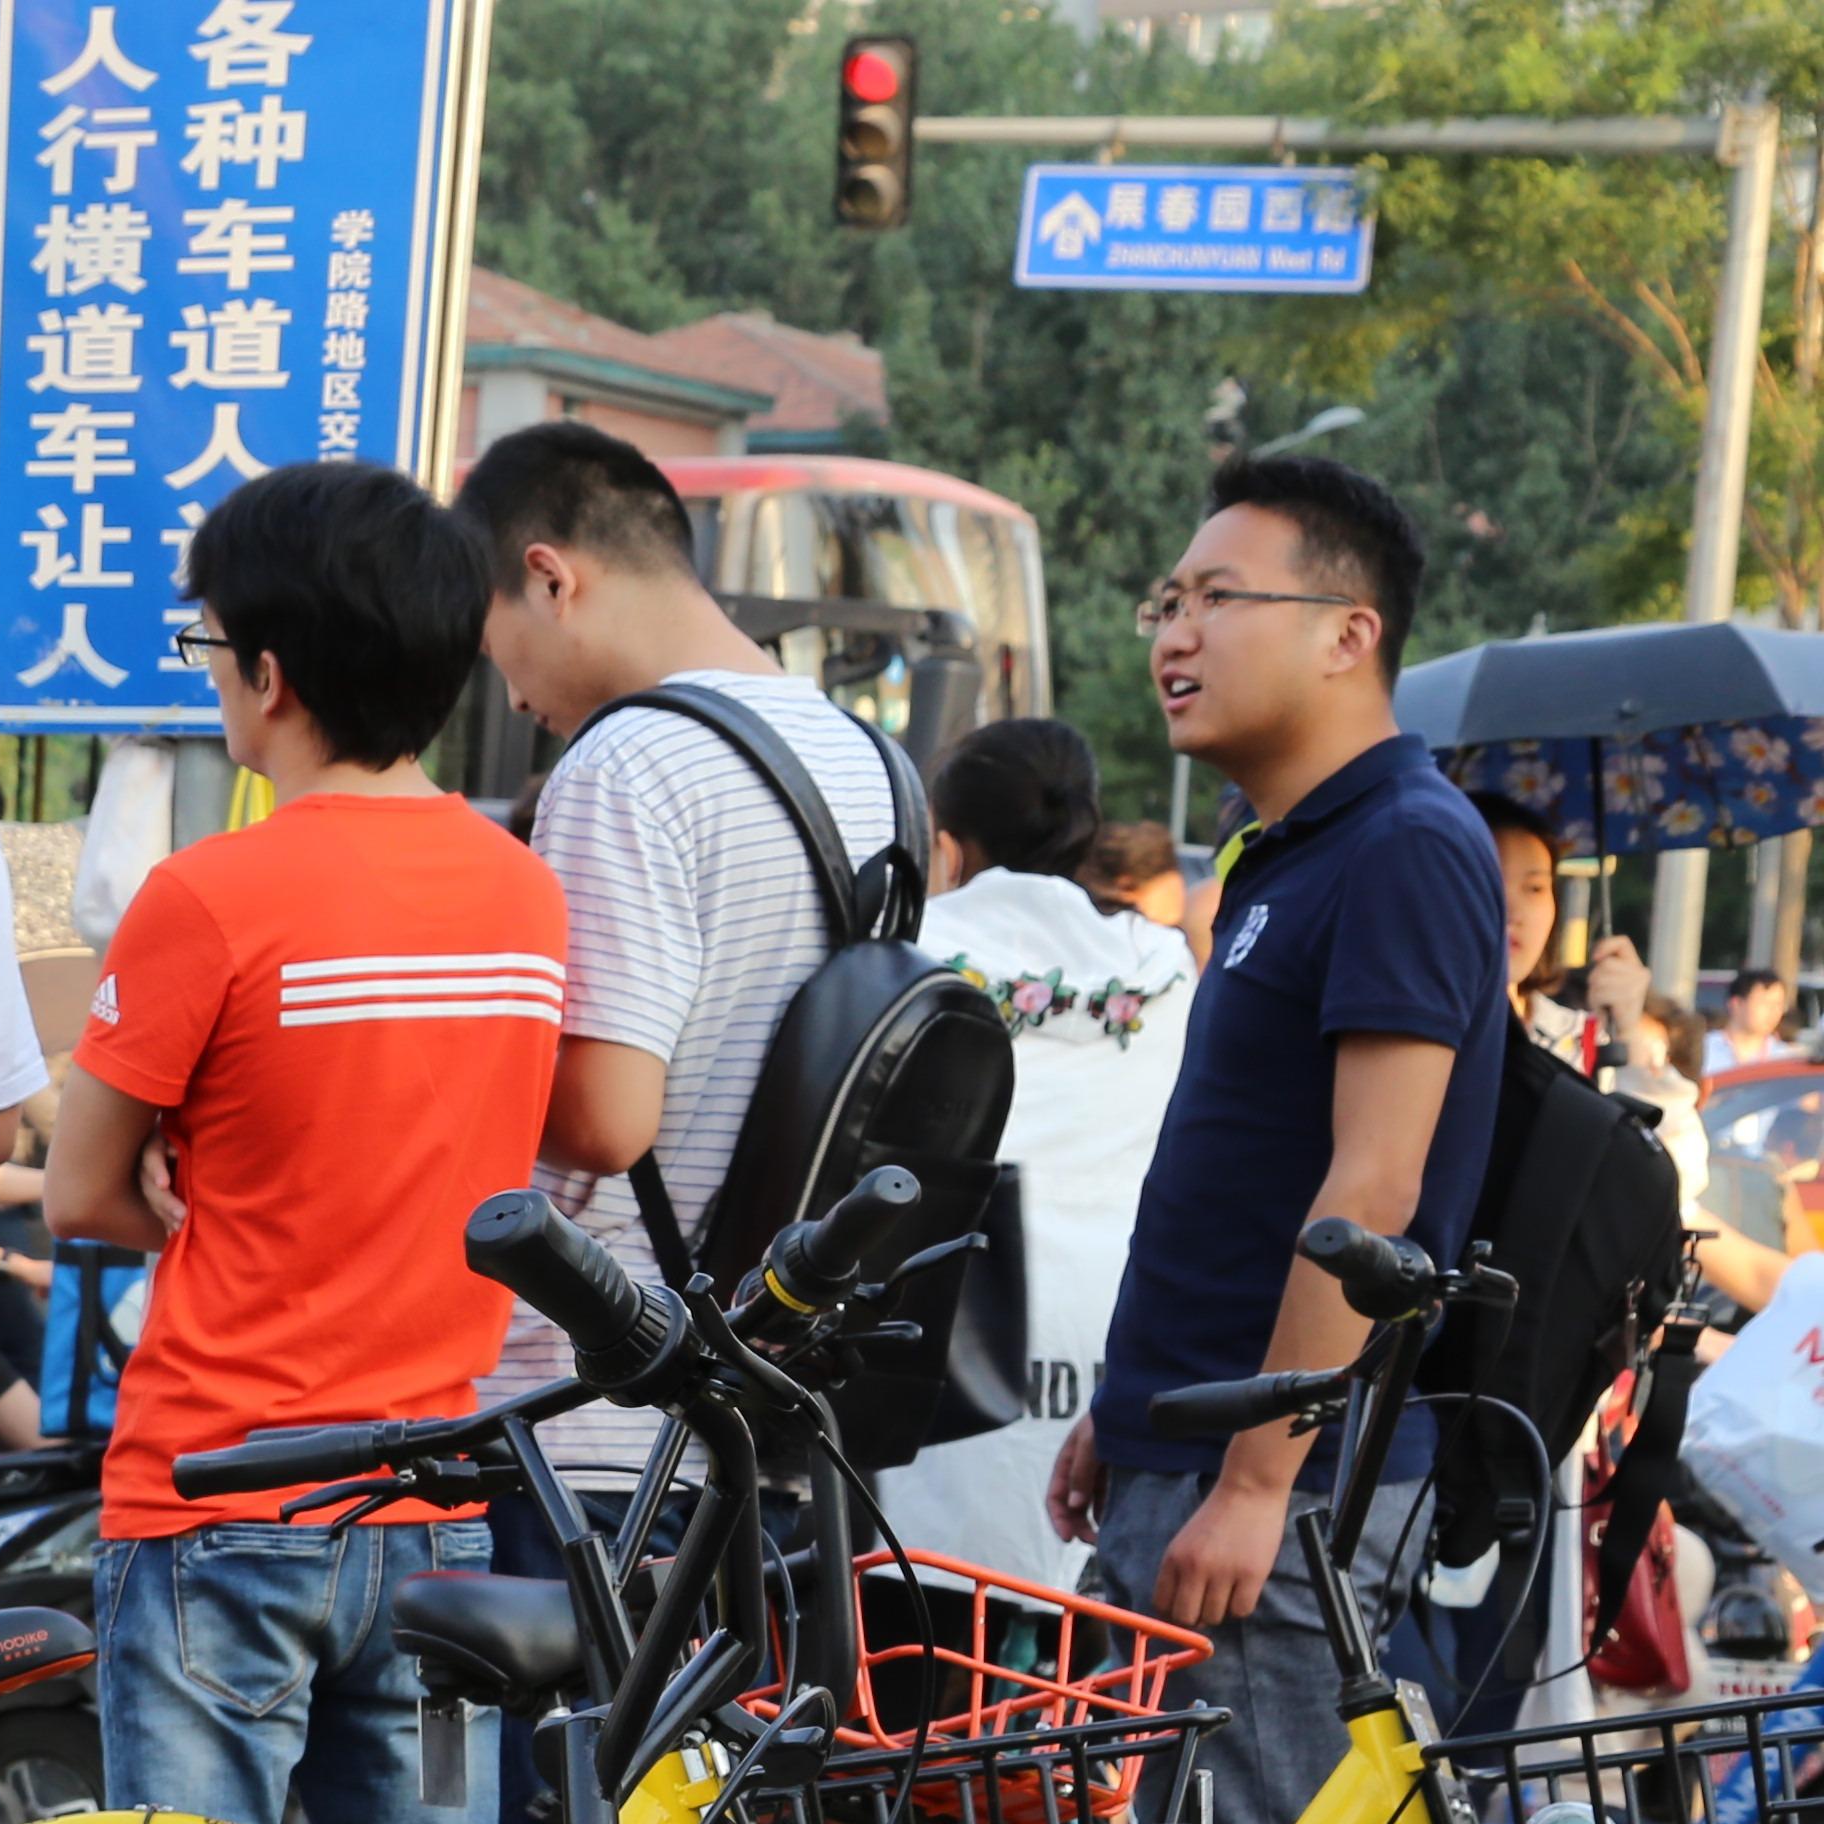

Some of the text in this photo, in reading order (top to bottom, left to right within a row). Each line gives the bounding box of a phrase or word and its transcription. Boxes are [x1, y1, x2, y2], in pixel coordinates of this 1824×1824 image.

[16, 7, 158, 688] 人行横道车让人
[317, 210, 375, 464] 学院路地区交
